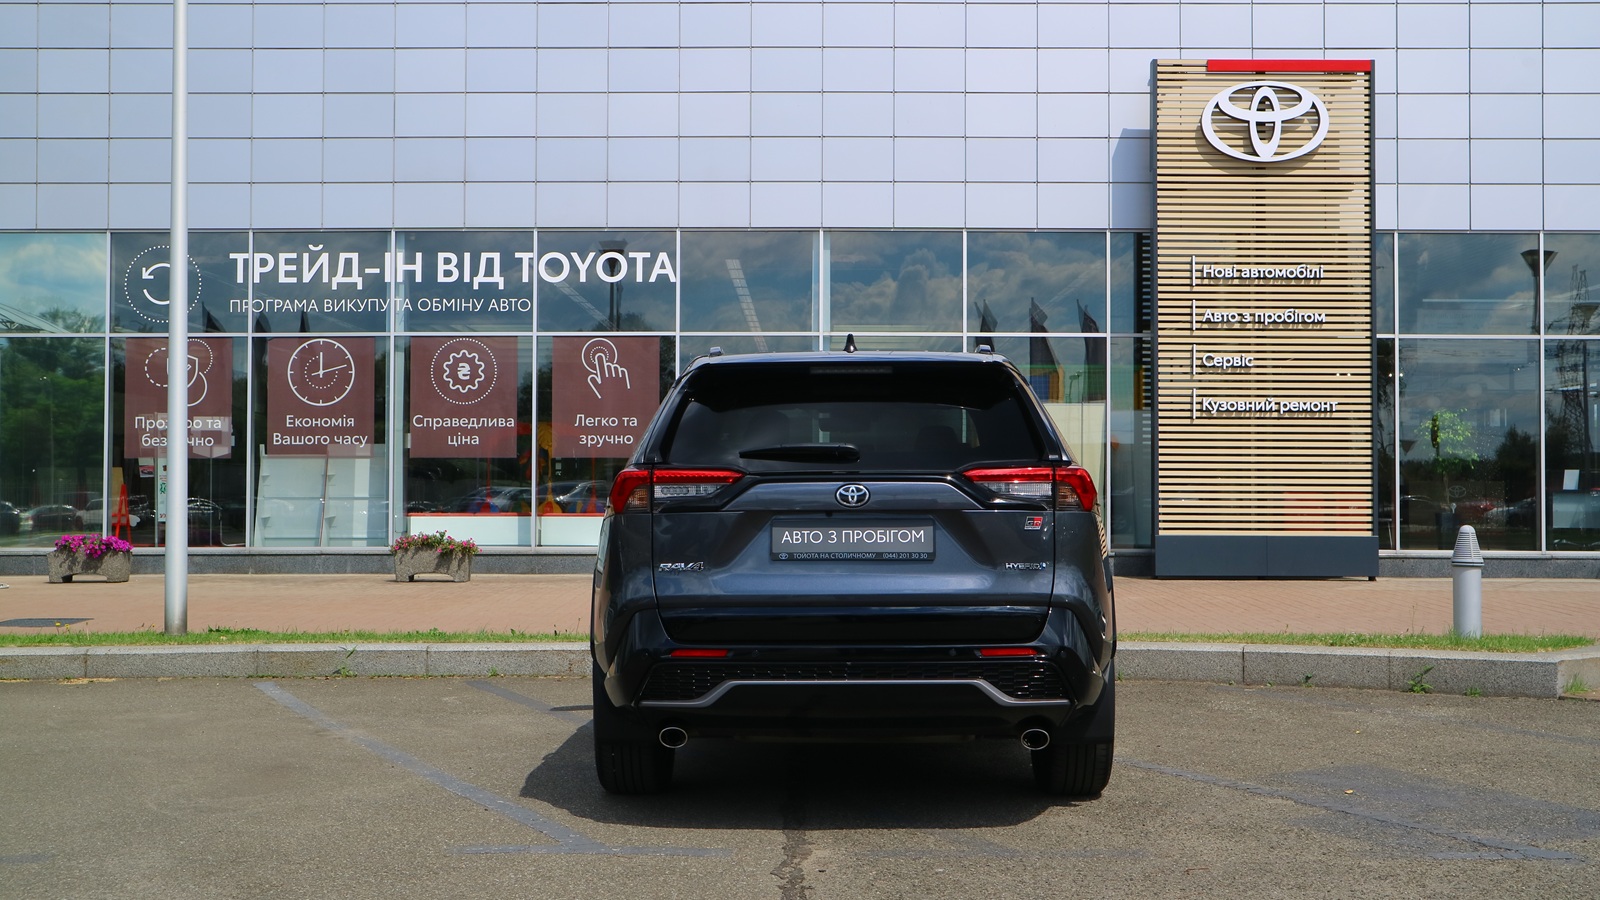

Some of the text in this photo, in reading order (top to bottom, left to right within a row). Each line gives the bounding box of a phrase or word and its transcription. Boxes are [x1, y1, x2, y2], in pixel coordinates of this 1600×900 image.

[229, 244, 676, 290] ТРЕЙД-ІН ВІД TOYOTA
[1203, 264, 1324, 278] Нові автомобілі
[229, 298, 531, 313] ПРОГРАМА ВИКУПУ ТА ОБМІНУ АВТО
[1203, 308, 1326, 326] Авто з пробігом
[1203, 353, 1254, 369] Сервіс
[1202, 397, 1338, 414] Кузовний ремонт
[207, 419, 222, 429] та
[286, 414, 355, 427] Економія
[412, 415, 515, 430] Справедлива
[574, 414, 638, 427] Легко та
[141, 433, 214, 446] безчно
[273, 432, 368, 448] Вашого часу
[448, 432, 479, 446] ціна
[579, 434, 634, 447] зручно
[781, 529, 925, 544] АВТО З ПРОБІГОМ
